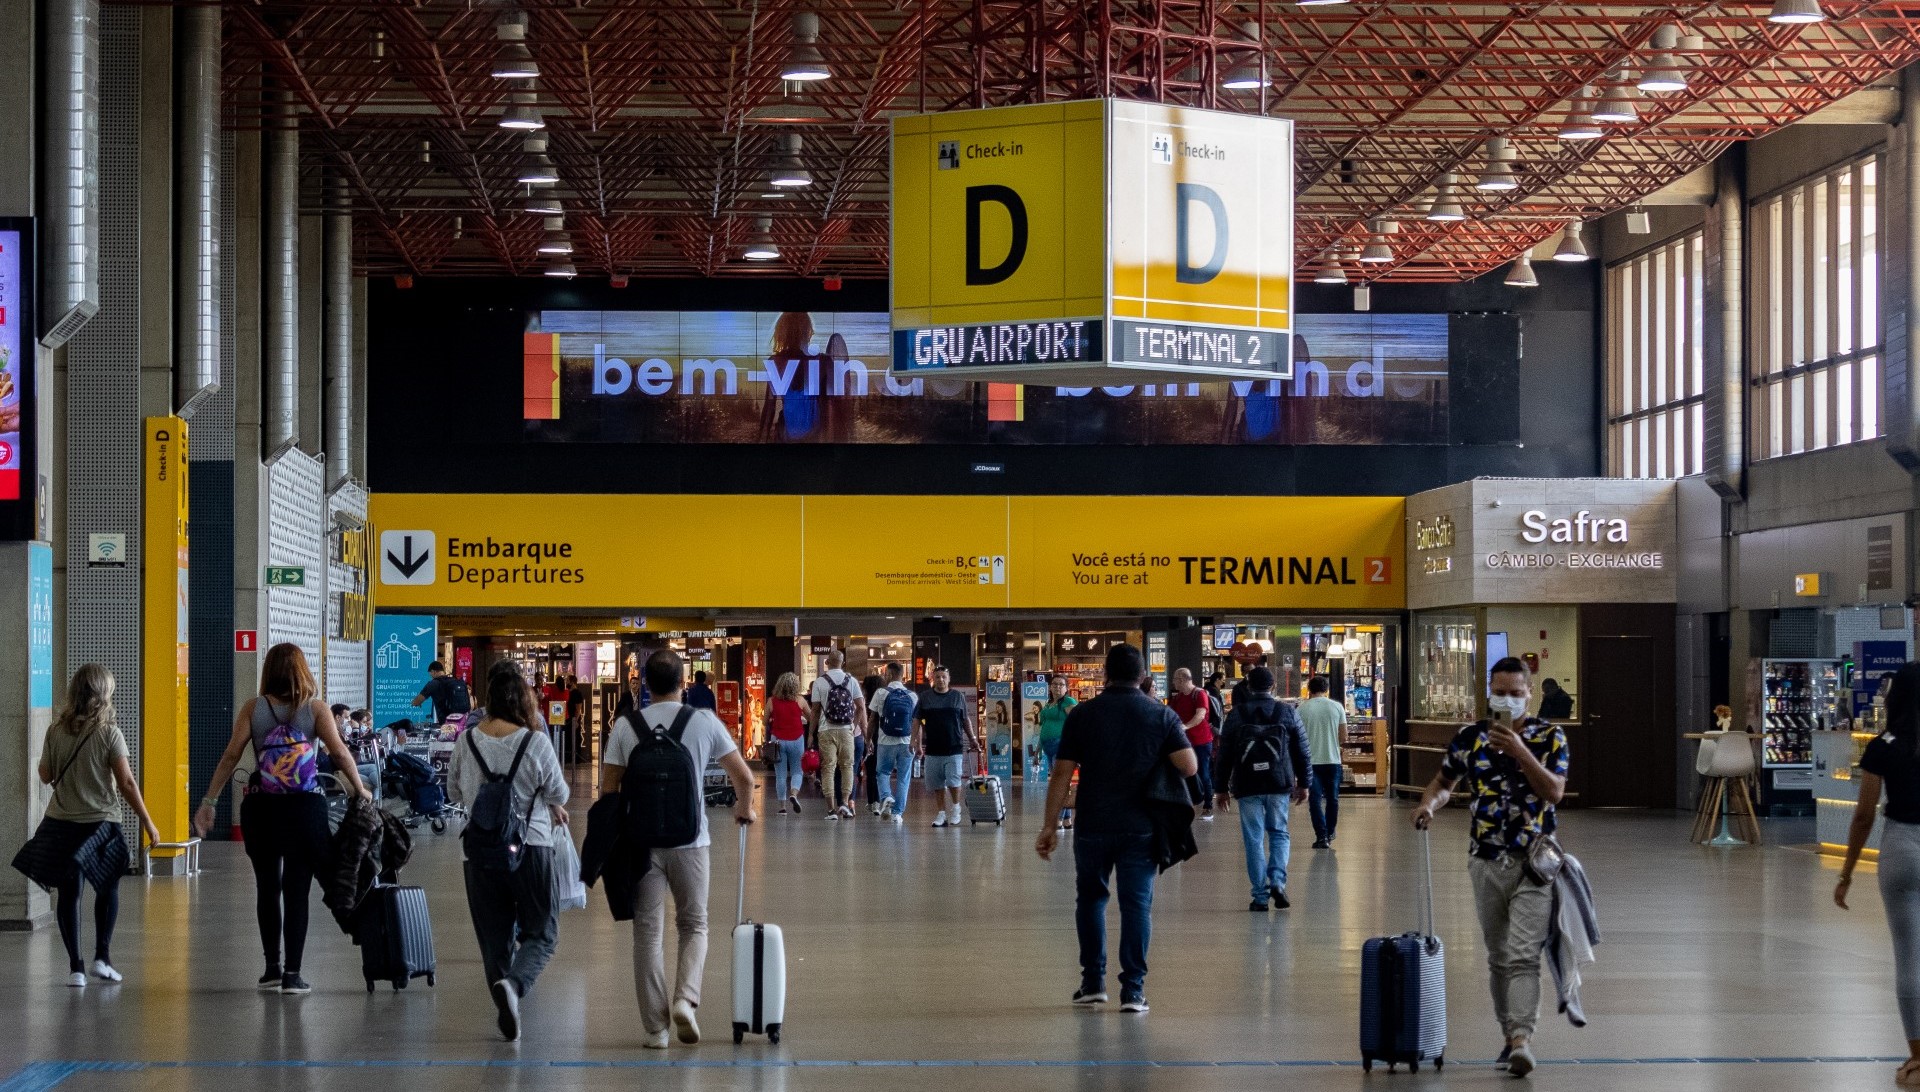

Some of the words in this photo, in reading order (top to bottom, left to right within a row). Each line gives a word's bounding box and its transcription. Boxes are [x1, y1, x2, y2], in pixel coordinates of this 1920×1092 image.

[966, 142, 1023, 158] Check-in
[1176, 141, 1226, 161] Check-in
[965, 184, 1029, 287] D
[1175, 182, 1230, 285] D
[969, 321, 1085, 364] AIRPORT
[1135, 326, 1243, 363] TERMINAL
[1246, 335, 1262, 365] 2
[155, 430, 170, 442] D
[158, 444, 167, 482] Check-in
[1521, 509, 1630, 544] Safra
[447, 537, 573, 564] Embarque
[956, 556, 977, 570] B,C
[1072, 553, 1109, 567] Você
[1113, 552, 1146, 567] está
[1150, 555, 1171, 567] no
[1486, 551, 1556, 568] CÂMBIO
[1568, 554, 1664, 568] EXCHANGE
[447, 563, 585, 589] Departures
[875, 572, 918, 580] Desembarque
[1072, 571, 1100, 585] You
[1104, 573, 1129, 585] are
[1132, 572, 1149, 585] at
[1178, 556, 1356, 585] TERMINAL
[1370, 559, 1386, 583] 2
